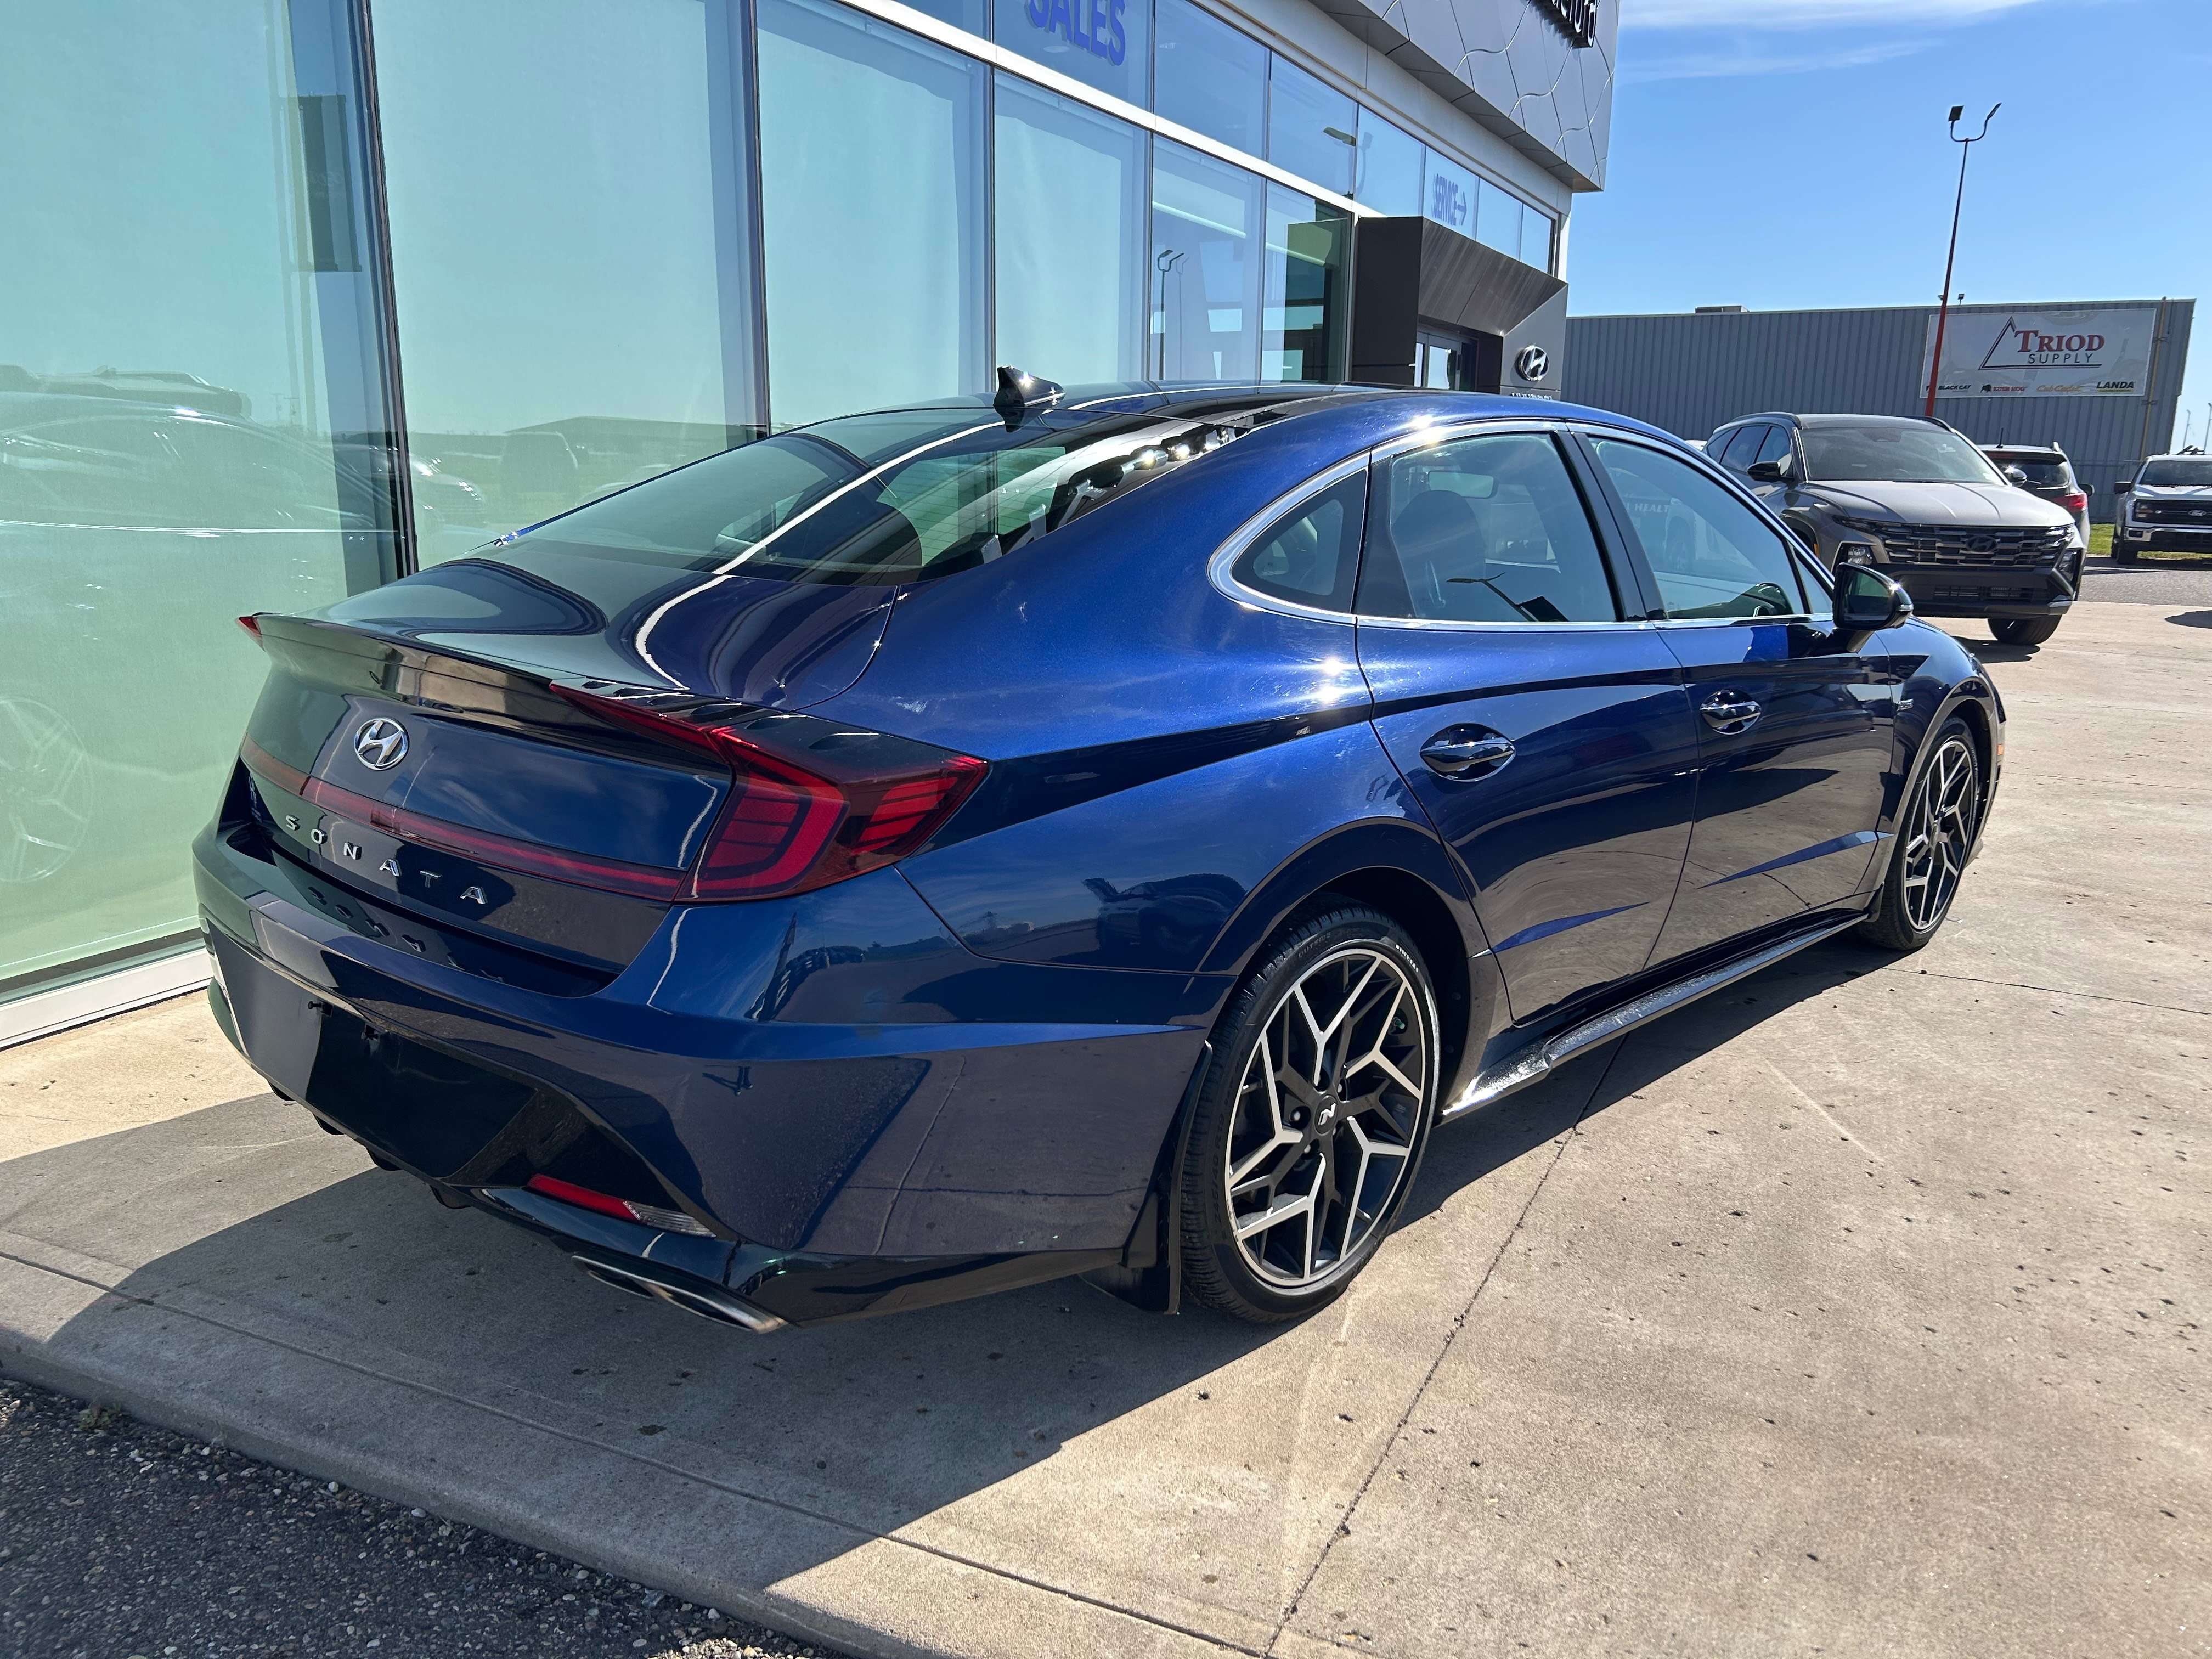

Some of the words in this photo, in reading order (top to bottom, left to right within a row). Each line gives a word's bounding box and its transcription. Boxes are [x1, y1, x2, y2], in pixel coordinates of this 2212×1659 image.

[1432, 173, 1458, 225] SERVICE
[2015, 330, 2105, 352] TRIOD
[2028, 353, 2094, 364] SUPPLY
[285, 815, 488, 905] SONATA
